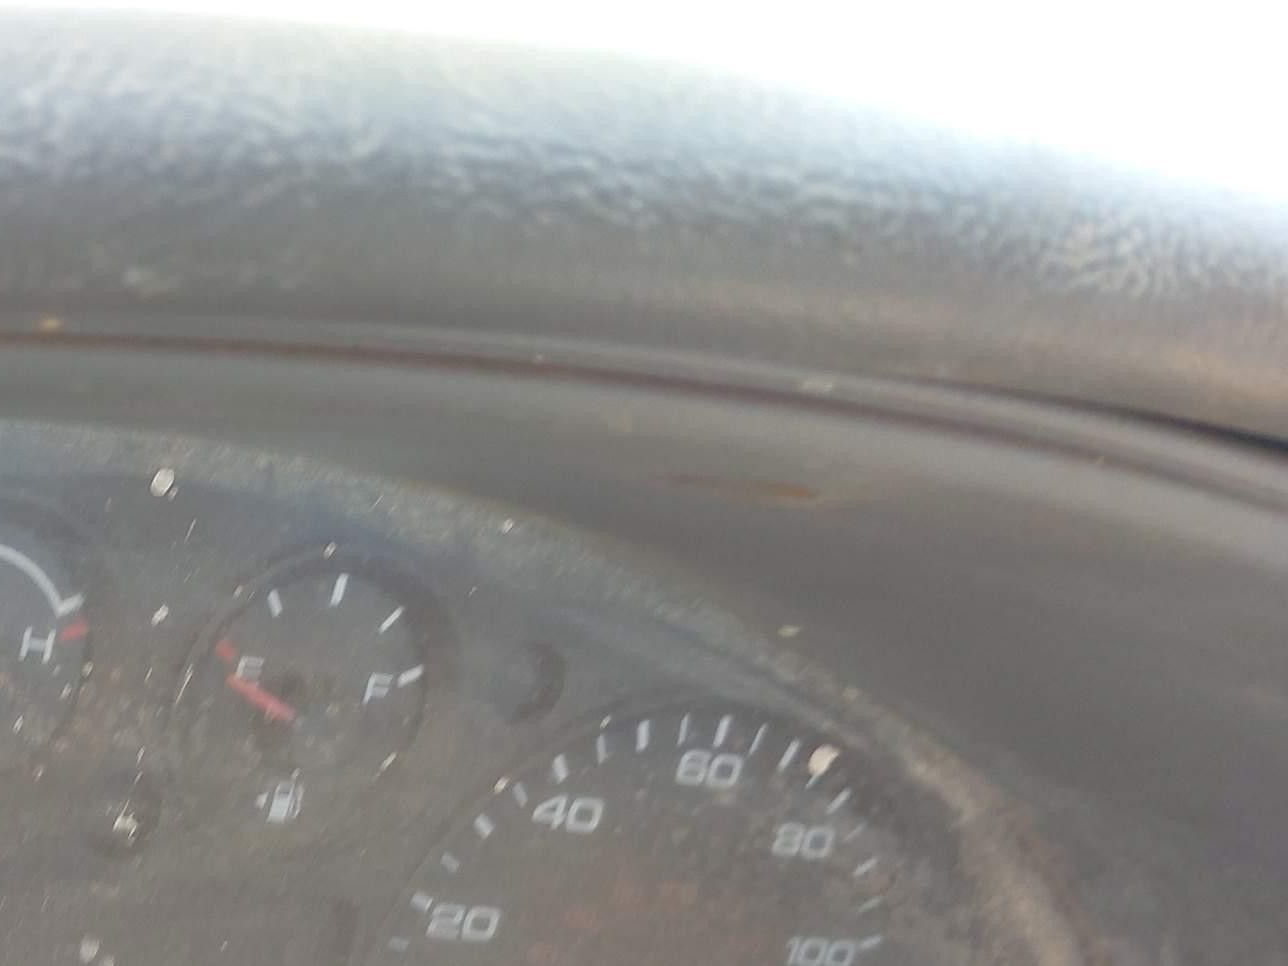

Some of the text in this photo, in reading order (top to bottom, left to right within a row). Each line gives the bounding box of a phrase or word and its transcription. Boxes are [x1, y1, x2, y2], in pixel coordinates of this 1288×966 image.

[18, 624, 57, 663] H
[362, 671, 397, 706] F
[674, 749, 744, 790] 60
[531, 795, 605, 836] 40
[771, 822, 836, 862] 80
[425, 903, 502, 943] 20
